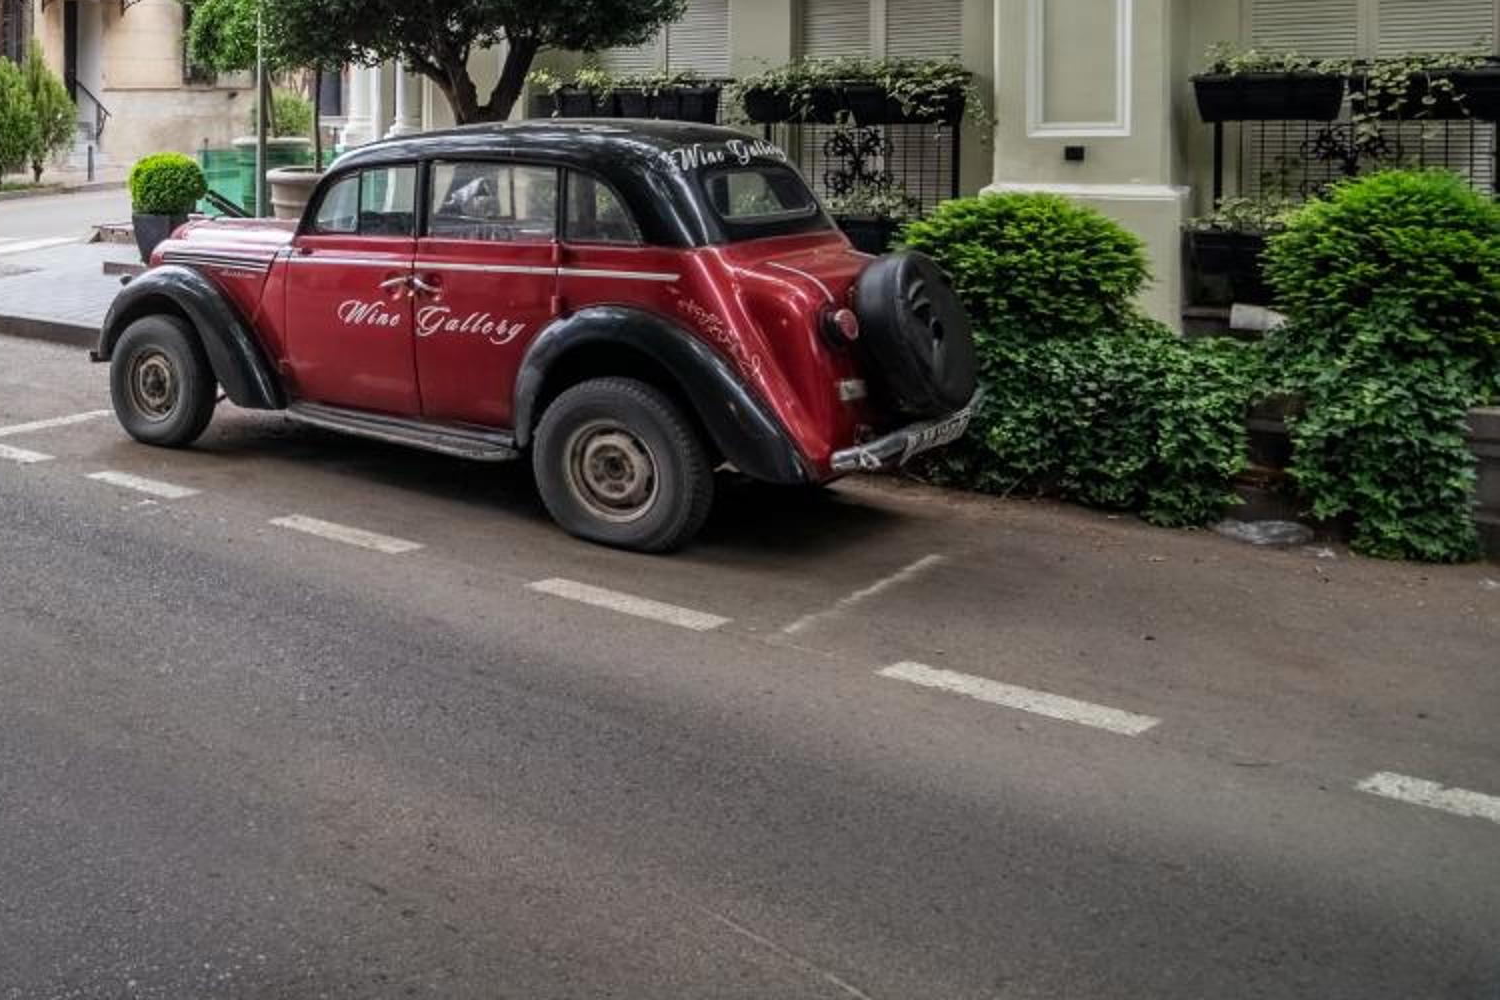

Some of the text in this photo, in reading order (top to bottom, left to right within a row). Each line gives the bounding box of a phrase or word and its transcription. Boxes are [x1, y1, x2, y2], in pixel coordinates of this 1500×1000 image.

[670, 143, 725, 171] Wine
[337, 299, 526, 345] Wine Gallery
